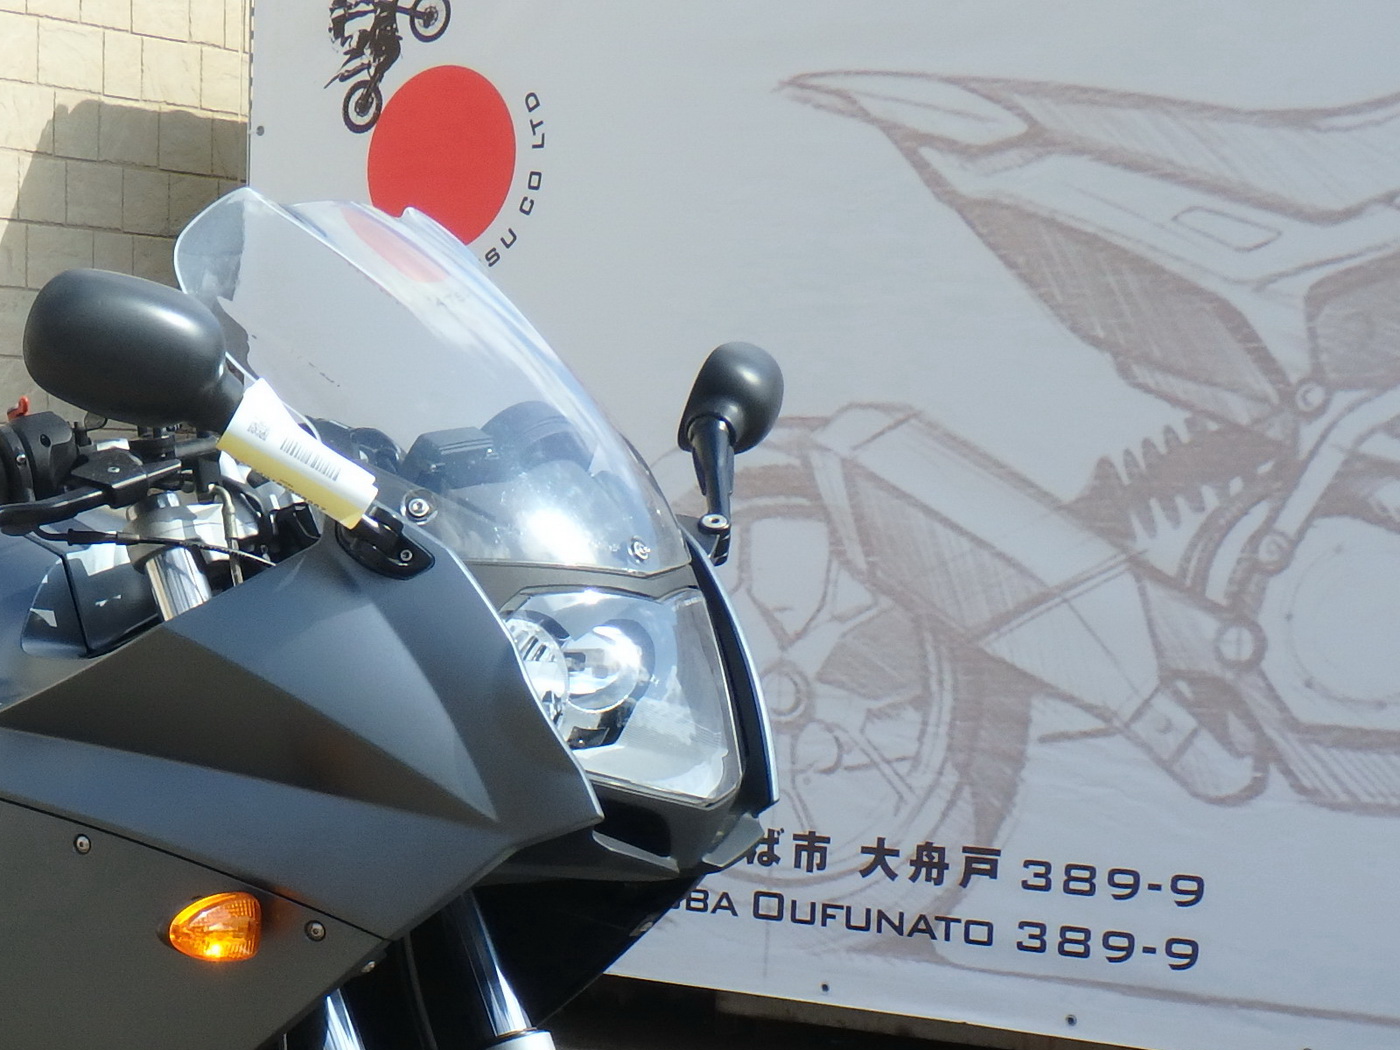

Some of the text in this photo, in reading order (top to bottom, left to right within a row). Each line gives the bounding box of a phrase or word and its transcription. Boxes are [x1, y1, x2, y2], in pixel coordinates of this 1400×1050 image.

[525, 92, 545, 149] LTD
[519, 170, 542, 216] CO
[858, 836, 1002, 889] 大舟戸
[1021, 859, 1205, 907] 389-9
[752, 890, 994, 947] OUFUNATO
[1016, 920, 1199, 971] 389-9
